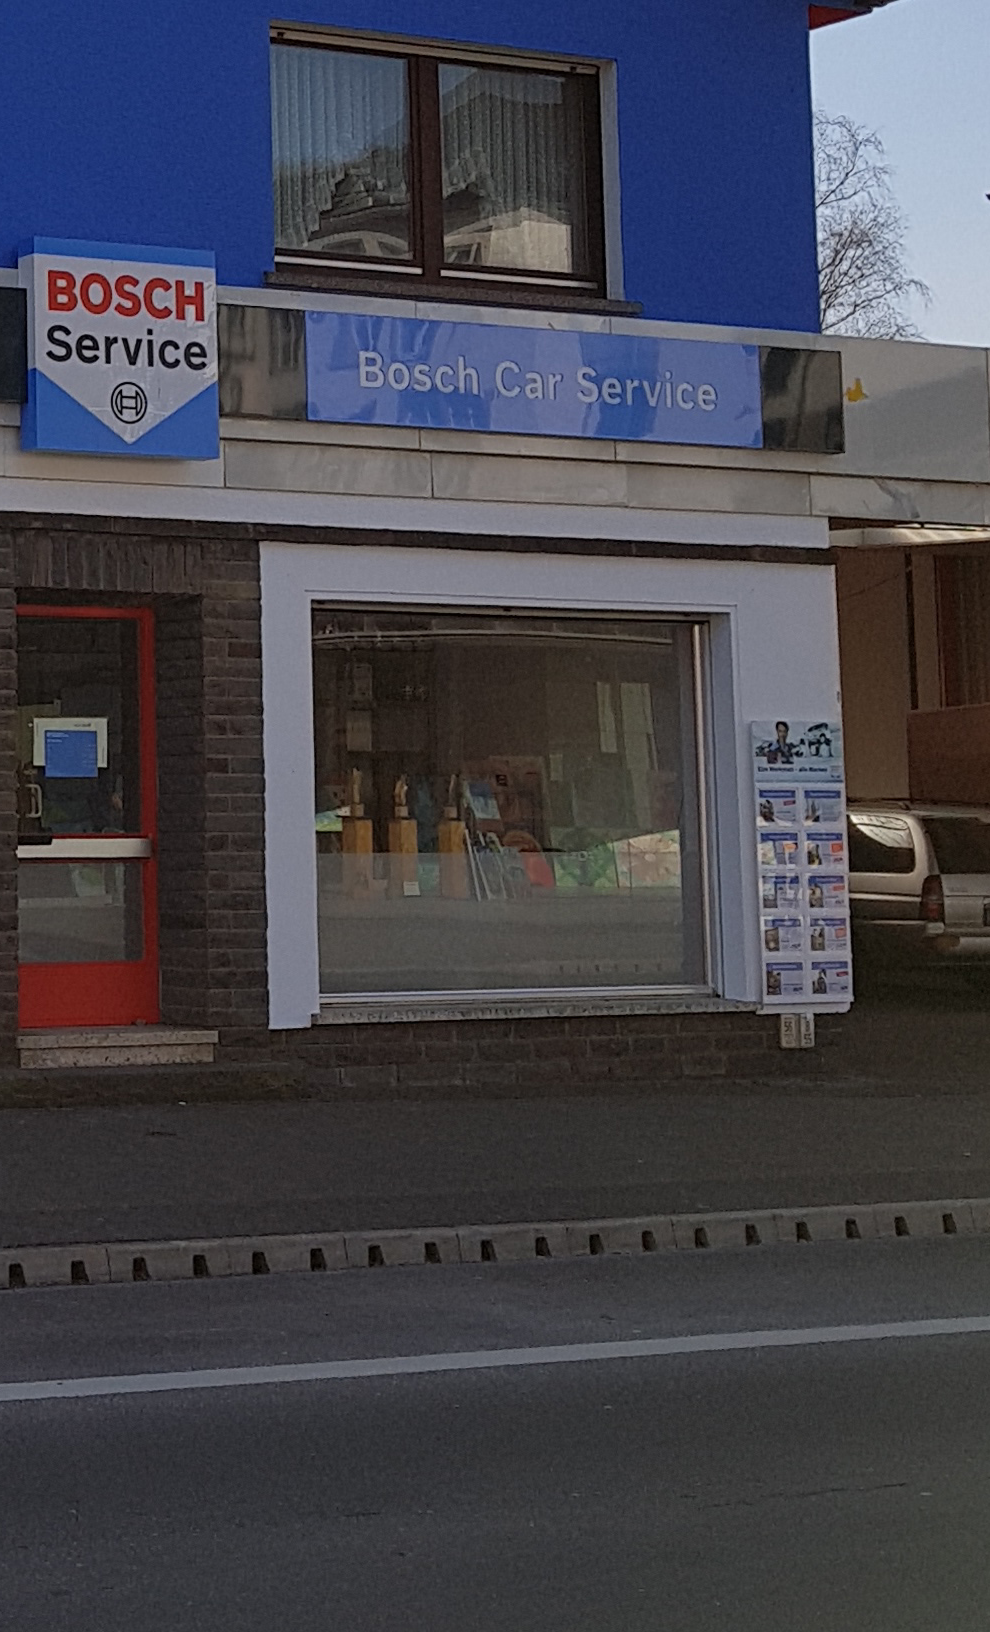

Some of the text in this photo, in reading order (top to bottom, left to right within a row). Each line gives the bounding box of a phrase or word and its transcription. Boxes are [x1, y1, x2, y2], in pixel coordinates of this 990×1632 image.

[47, 270, 205, 321] BOSCH
[45, 324, 208, 371] Service
[358, 350, 718, 412] Bosch Car Service
